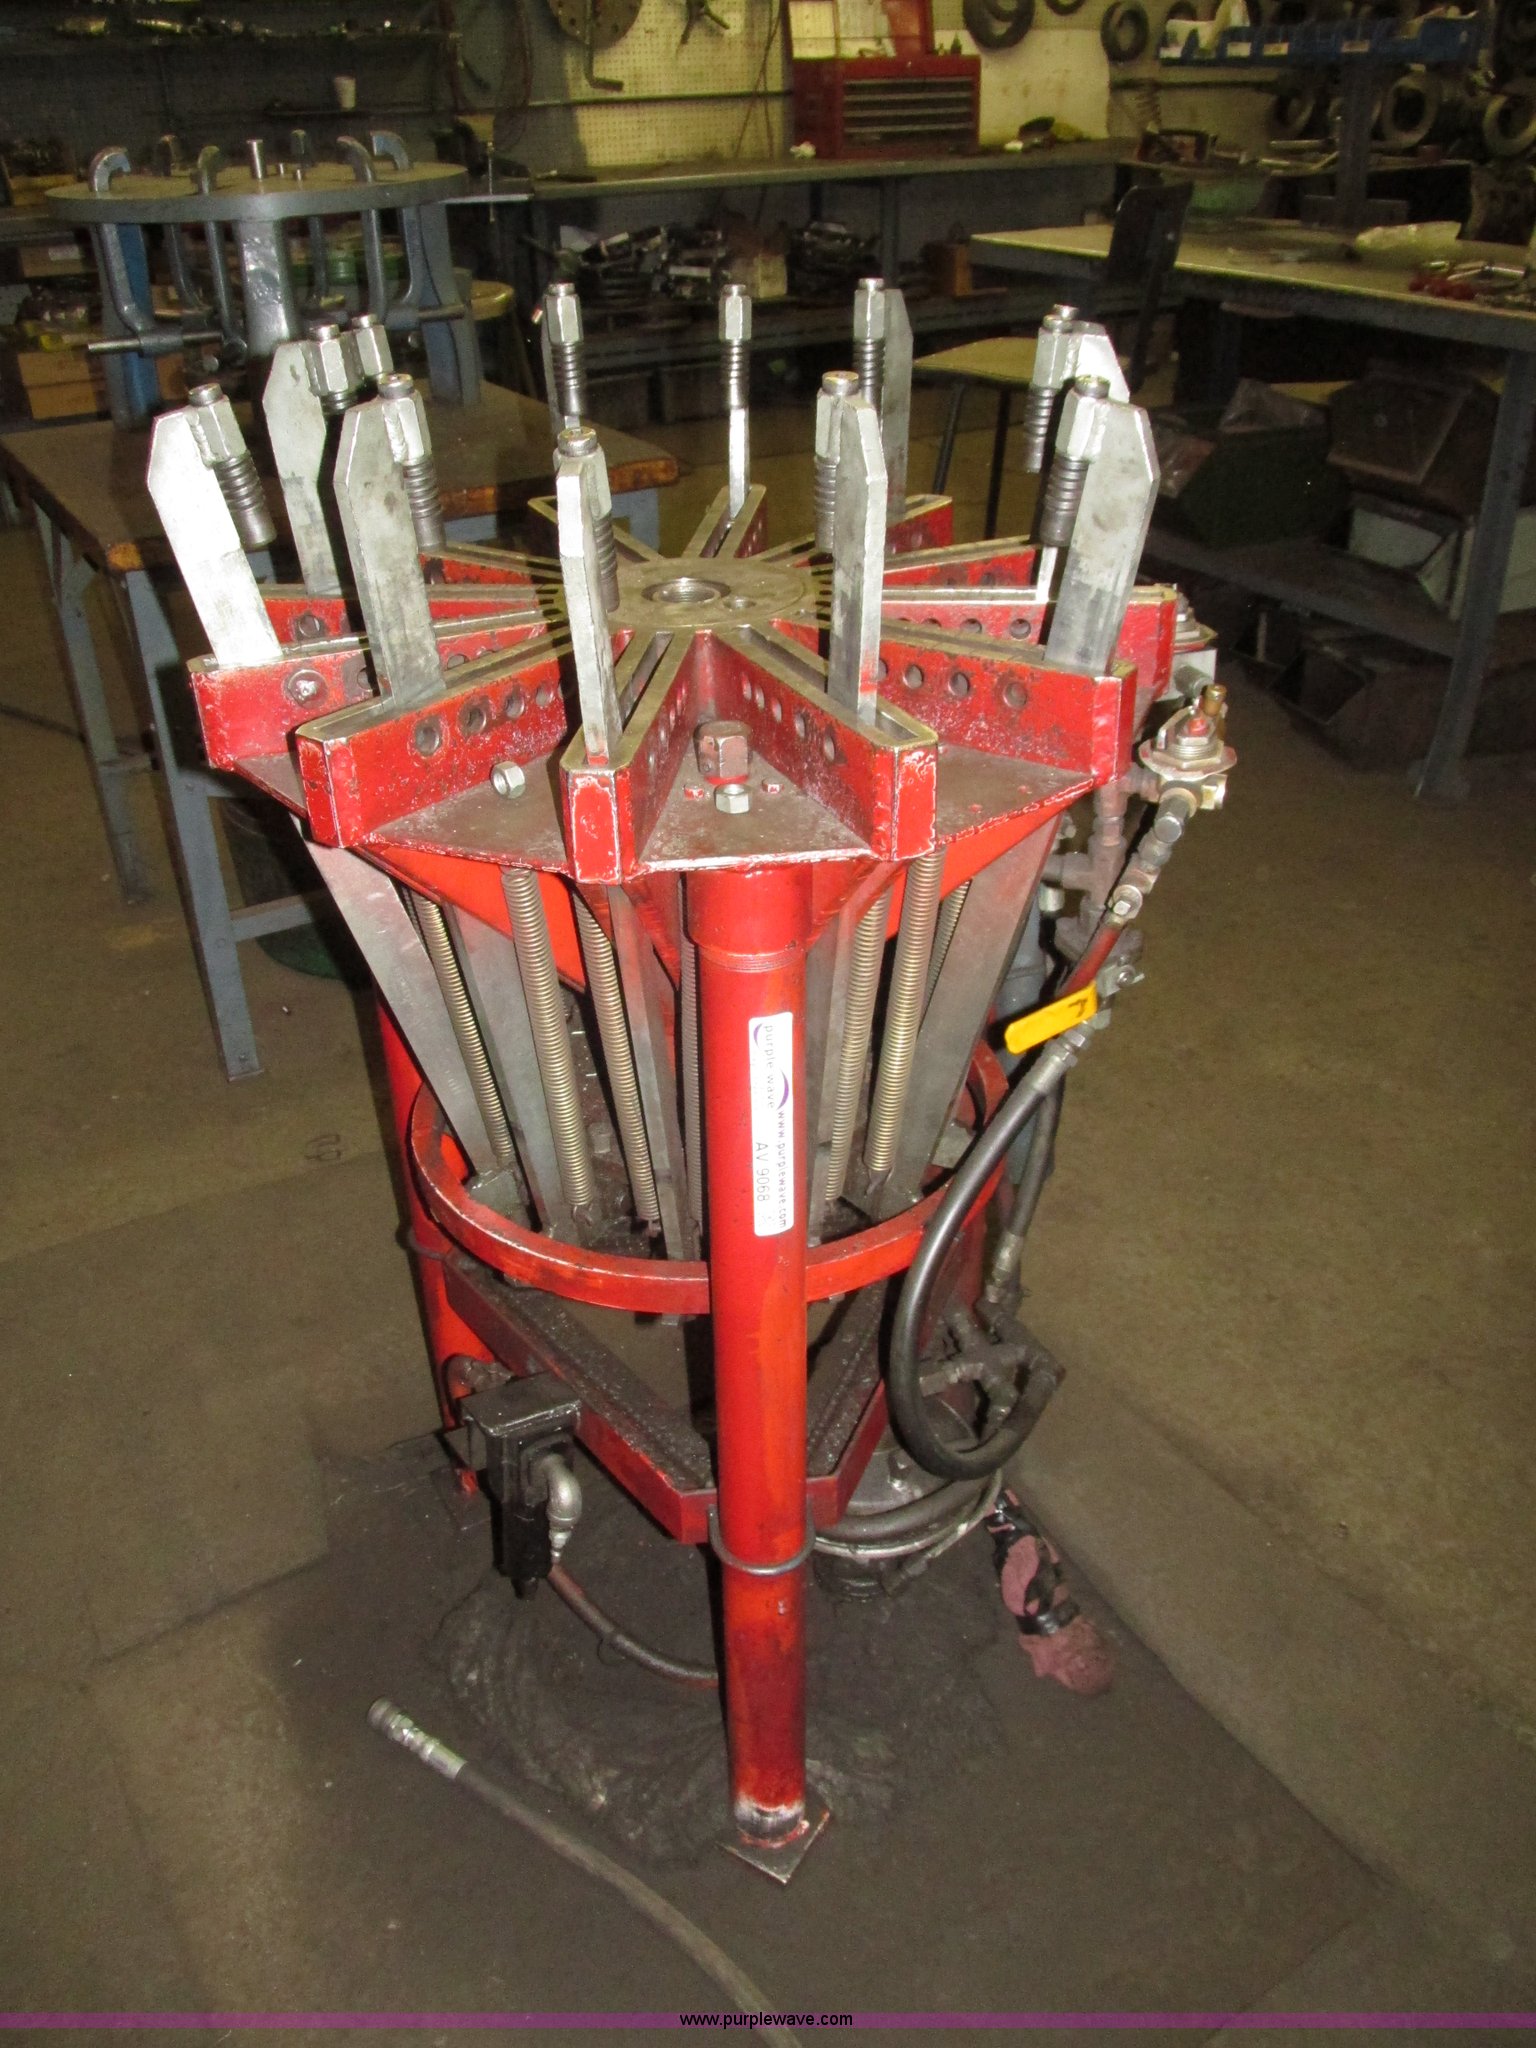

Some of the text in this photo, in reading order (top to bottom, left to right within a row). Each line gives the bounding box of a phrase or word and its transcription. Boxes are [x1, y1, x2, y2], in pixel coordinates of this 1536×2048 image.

[763, 1025, 775, 1109] purple wave
[754, 1141, 770, 1203] AV 9068
[776, 1110, 788, 1229] www.purplewave.com
